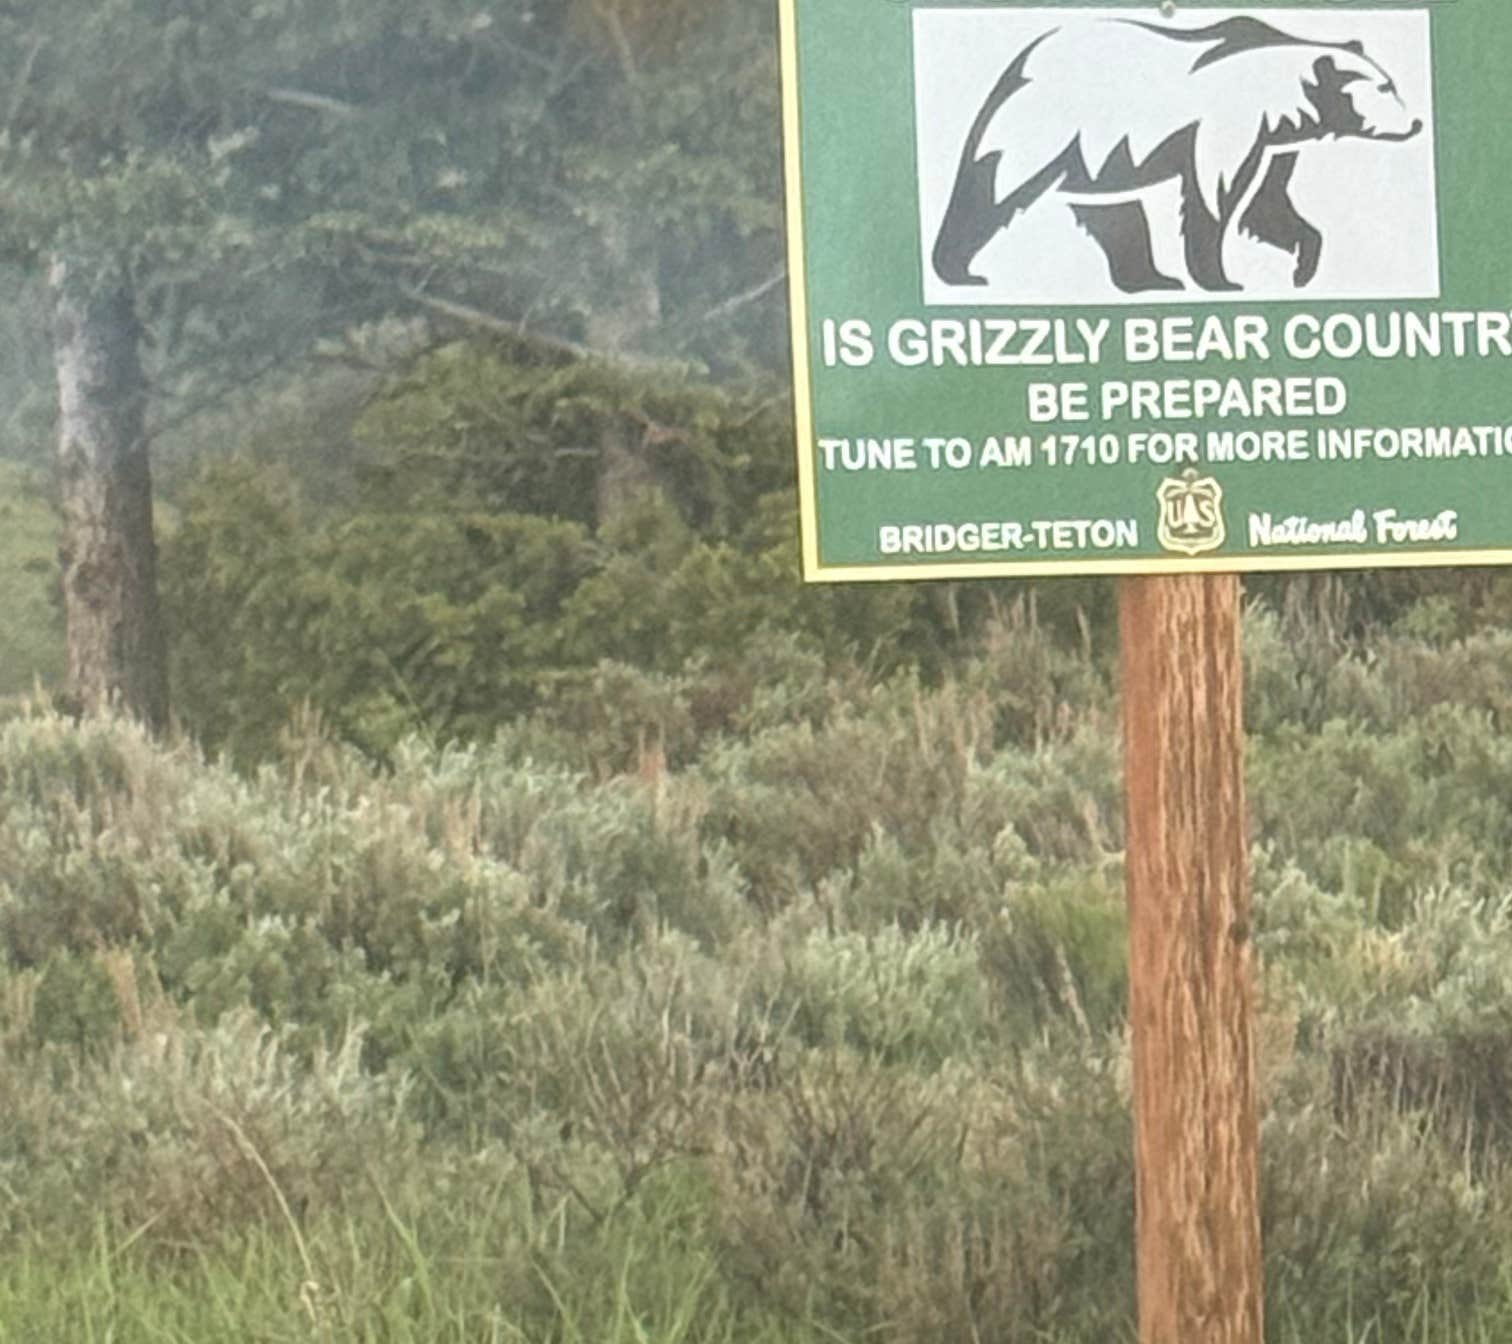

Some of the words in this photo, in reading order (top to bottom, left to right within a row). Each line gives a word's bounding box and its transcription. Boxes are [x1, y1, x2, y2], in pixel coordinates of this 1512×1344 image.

[822, 318, 874, 367] IS
[888, 318, 1110, 366] GRIZZLY
[1124, 315, 1270, 362] BEAR
[1028, 382, 1090, 422] BE
[1101, 376, 1347, 420] PREPARED
[817, 438, 917, 470] TUNE
[922, 437, 972, 469] TO
[979, 436, 1032, 467] AM
[1041, 433, 1120, 466] 1710
[1128, 432, 1199, 463] FOR
[1207, 429, 1310, 462] MORE
[879, 519, 1138, 554] BRIDGER-TETON
[1248, 509, 1368, 547] National
[1372, 508, 1457, 544] Forest
